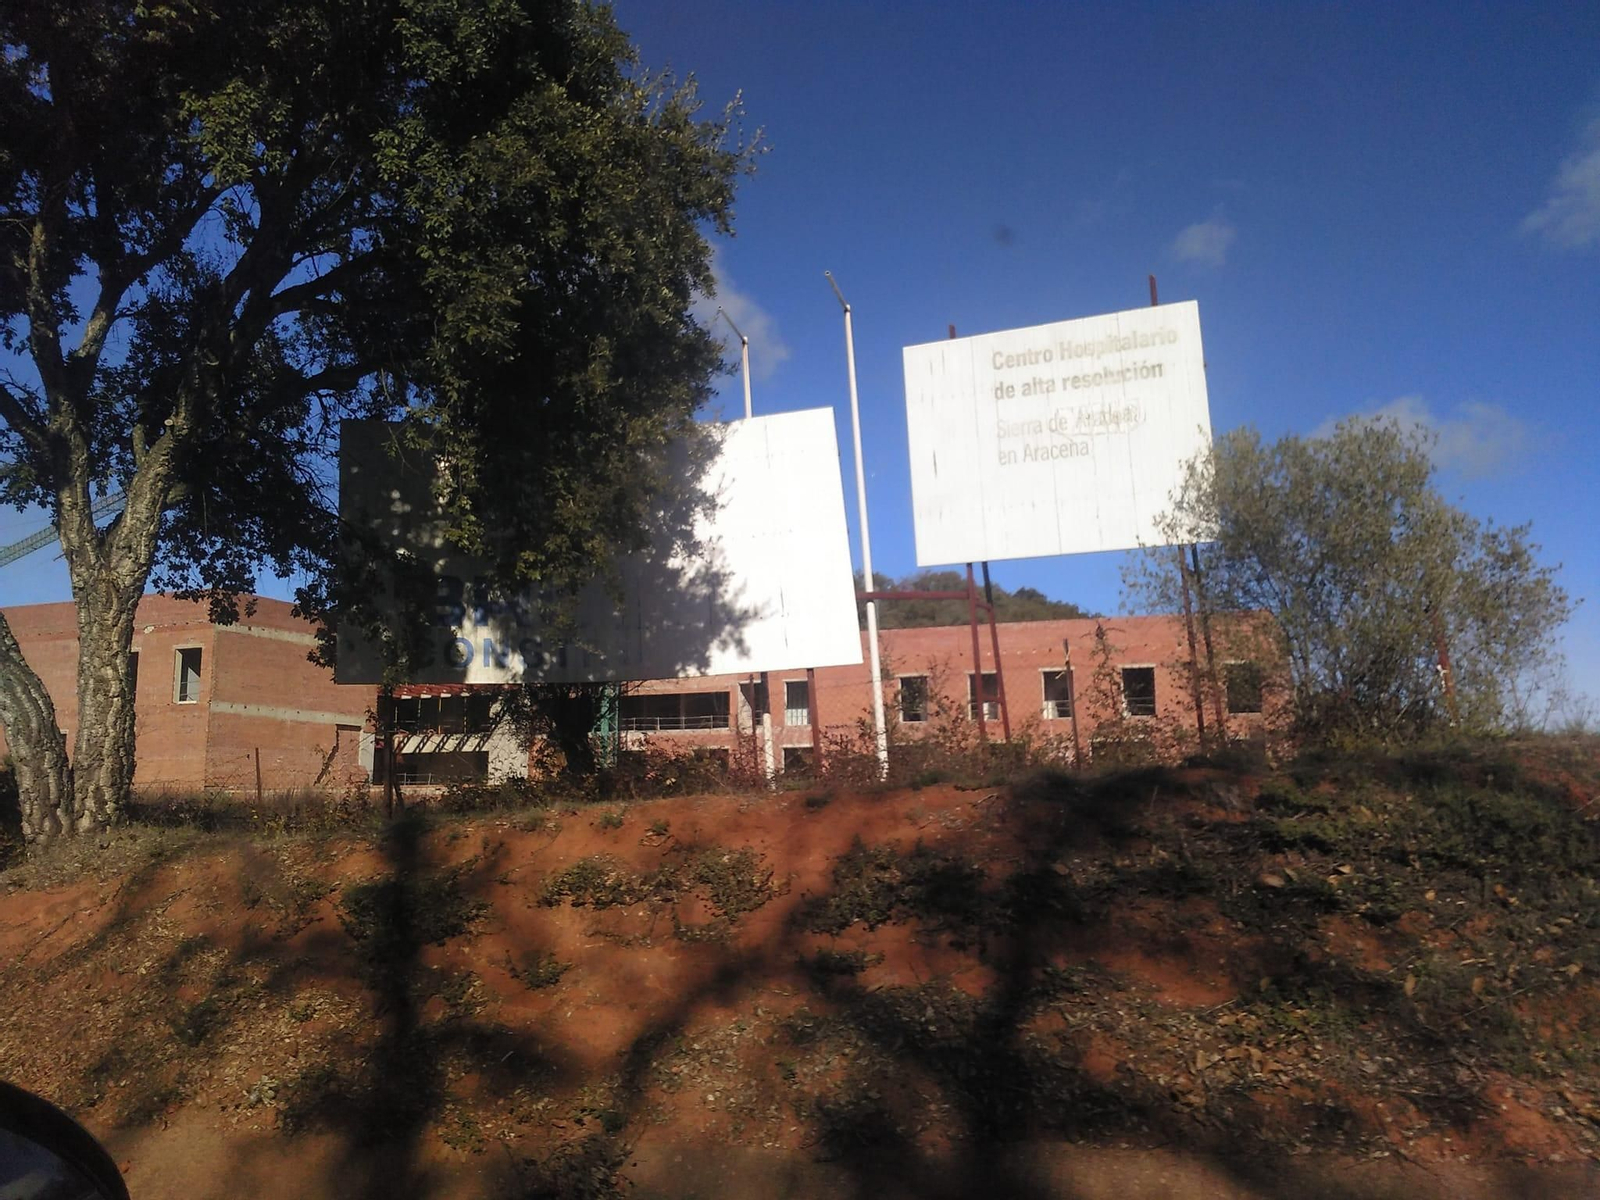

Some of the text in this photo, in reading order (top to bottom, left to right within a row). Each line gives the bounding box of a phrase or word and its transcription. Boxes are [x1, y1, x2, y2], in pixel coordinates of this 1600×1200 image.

[992, 328, 1177, 371] Centro Hospitalario
[994, 360, 1164, 400] de alta resolución
[996, 420, 1043, 439] Sierra
[1049, 410, 1068, 432] de
[999, 440, 1090, 465] en Aracena
